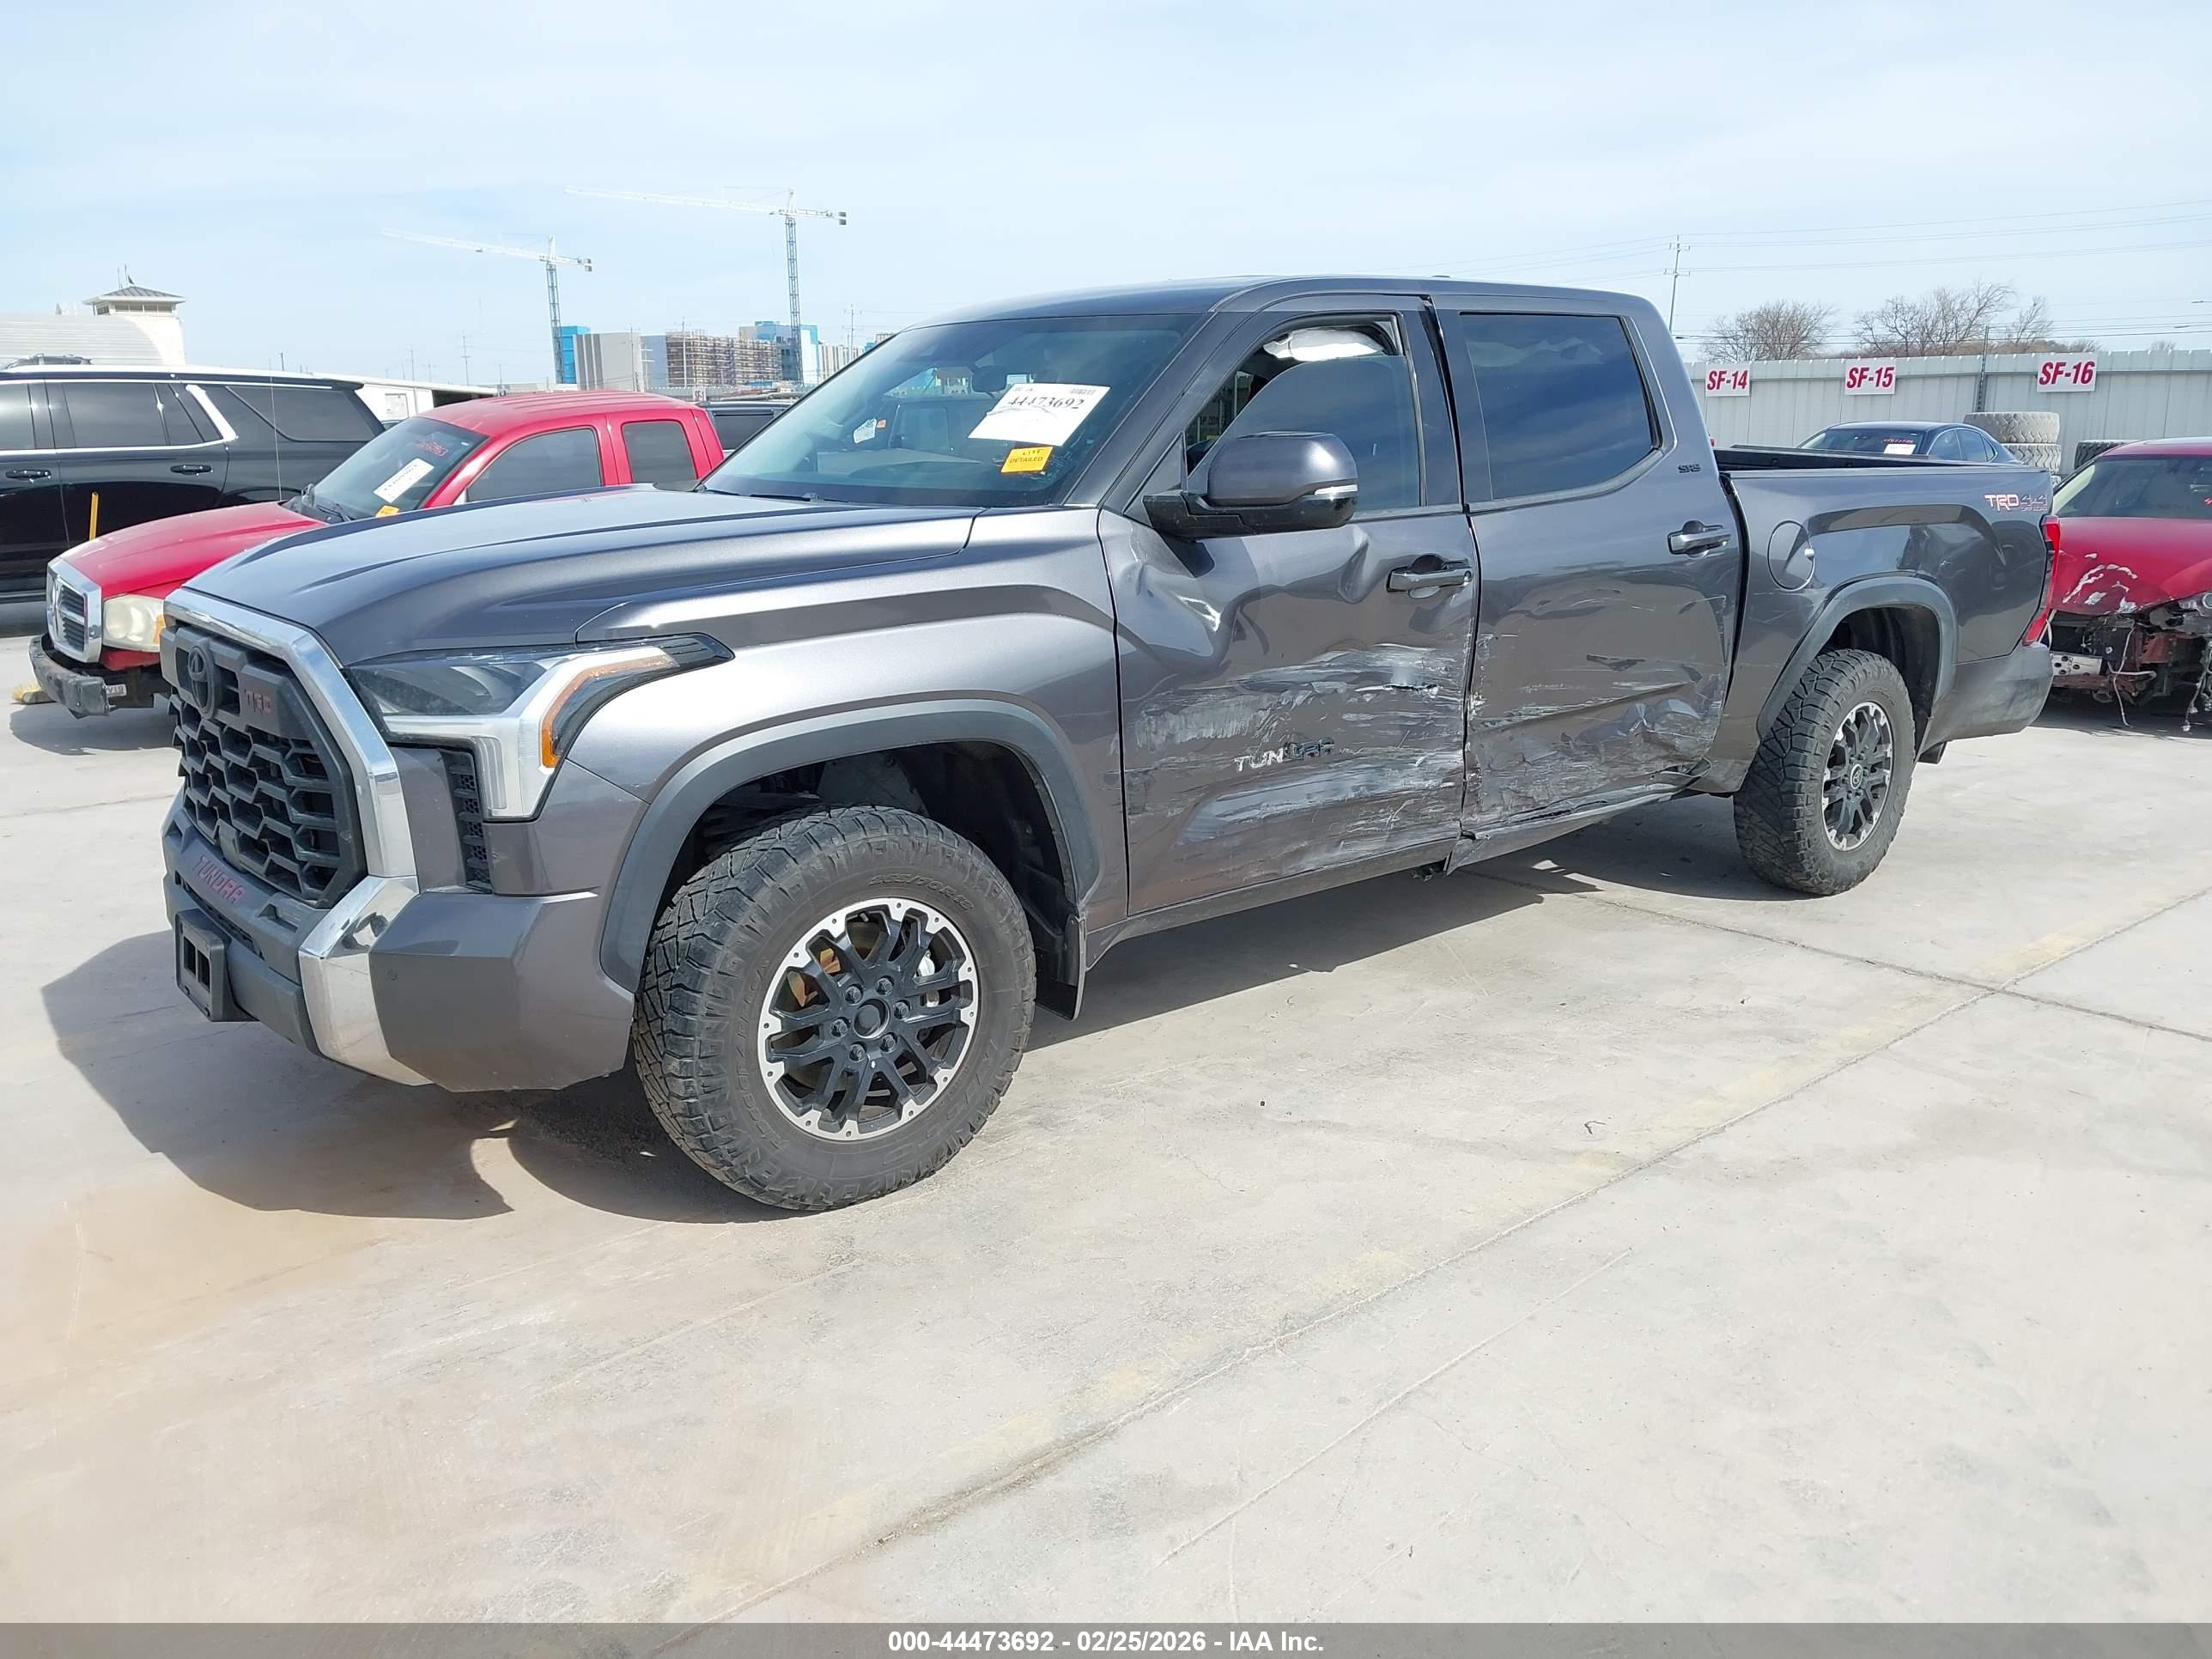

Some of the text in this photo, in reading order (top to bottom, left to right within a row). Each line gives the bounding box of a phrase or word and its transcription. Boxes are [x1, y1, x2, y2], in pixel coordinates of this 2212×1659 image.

[1706, 369, 1749, 391] SF-14
[1846, 367, 1895, 389] SF-15
[2039, 361, 2095, 385] SF-16
[1984, 494, 2020, 512] TRD
[191, 854, 248, 907] TUNDRA
